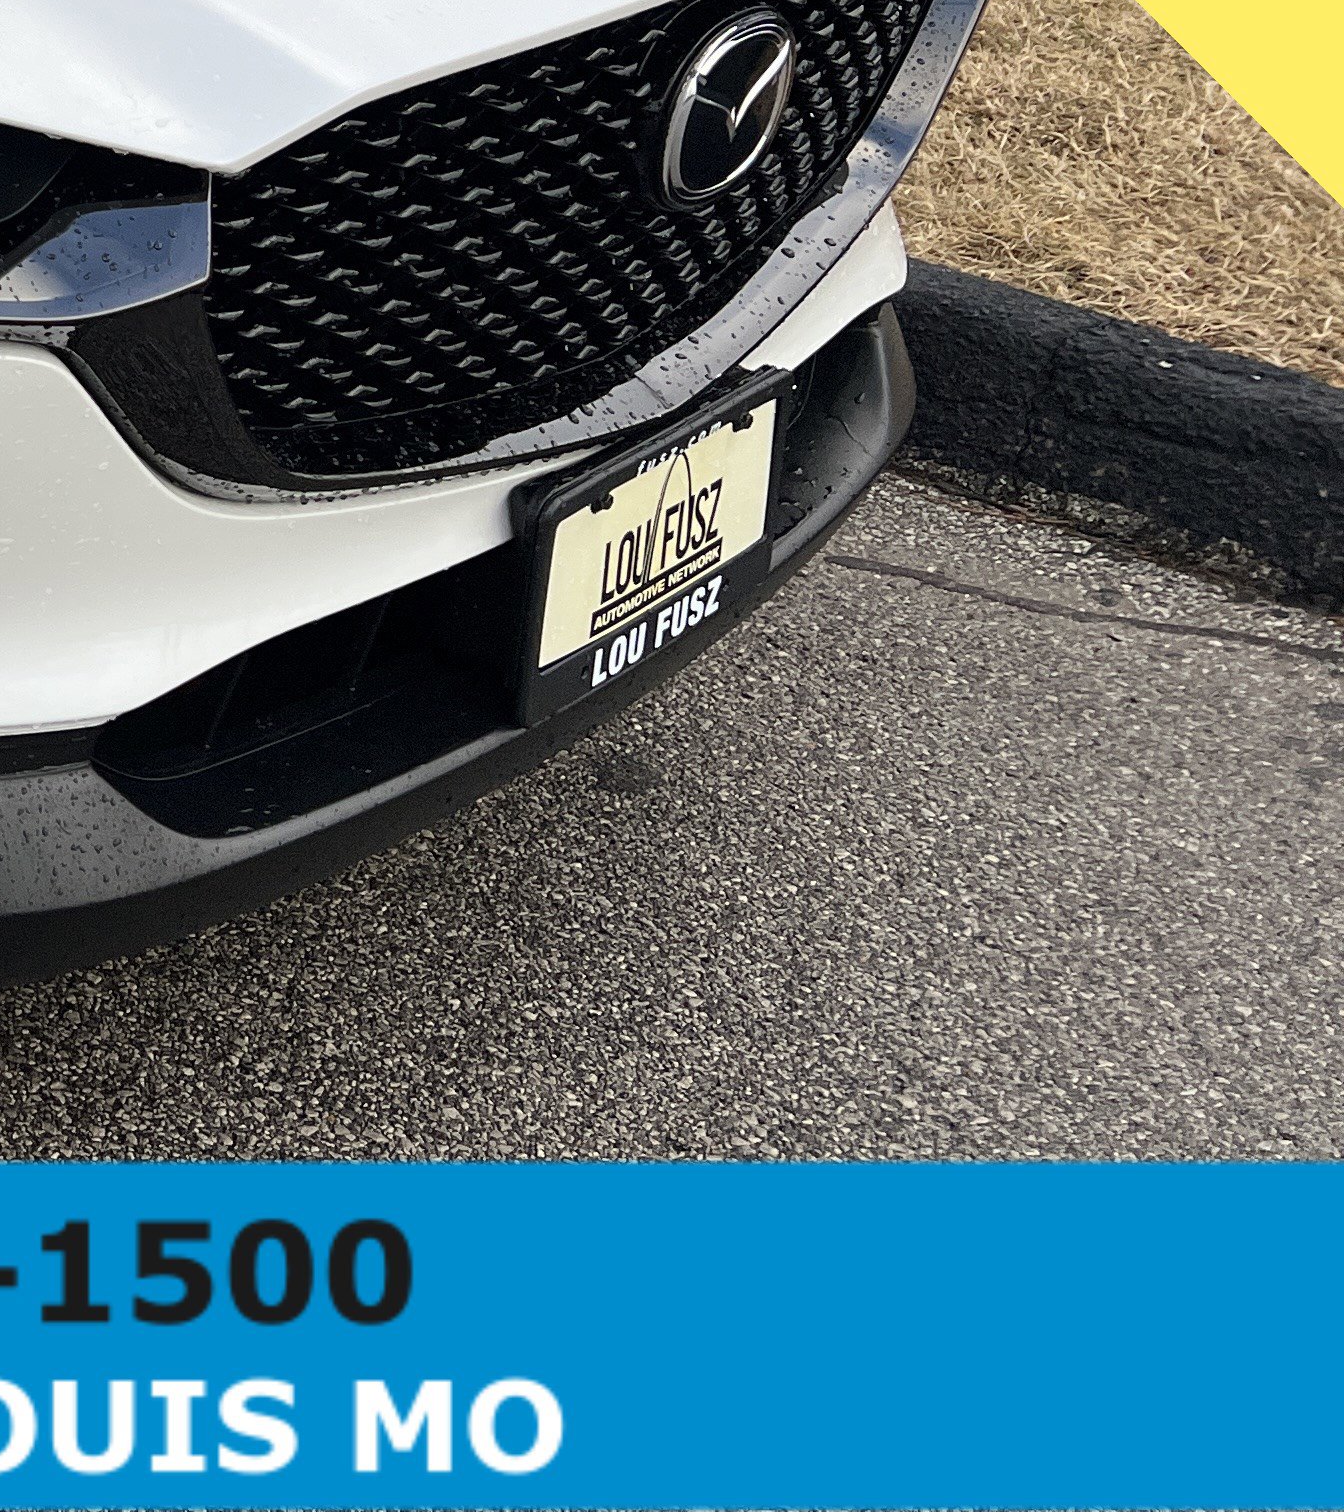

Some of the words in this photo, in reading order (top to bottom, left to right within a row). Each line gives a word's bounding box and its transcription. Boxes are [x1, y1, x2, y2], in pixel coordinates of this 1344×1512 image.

[593, 580, 666, 630] AUTOMOTIVE
[667, 546, 721, 587] NETWORK
[601, 517, 653, 606] LOU
[660, 477, 723, 573] FUSZ
[591, 621, 648, 687] LOU
[654, 575, 723, 649] FUSZ
